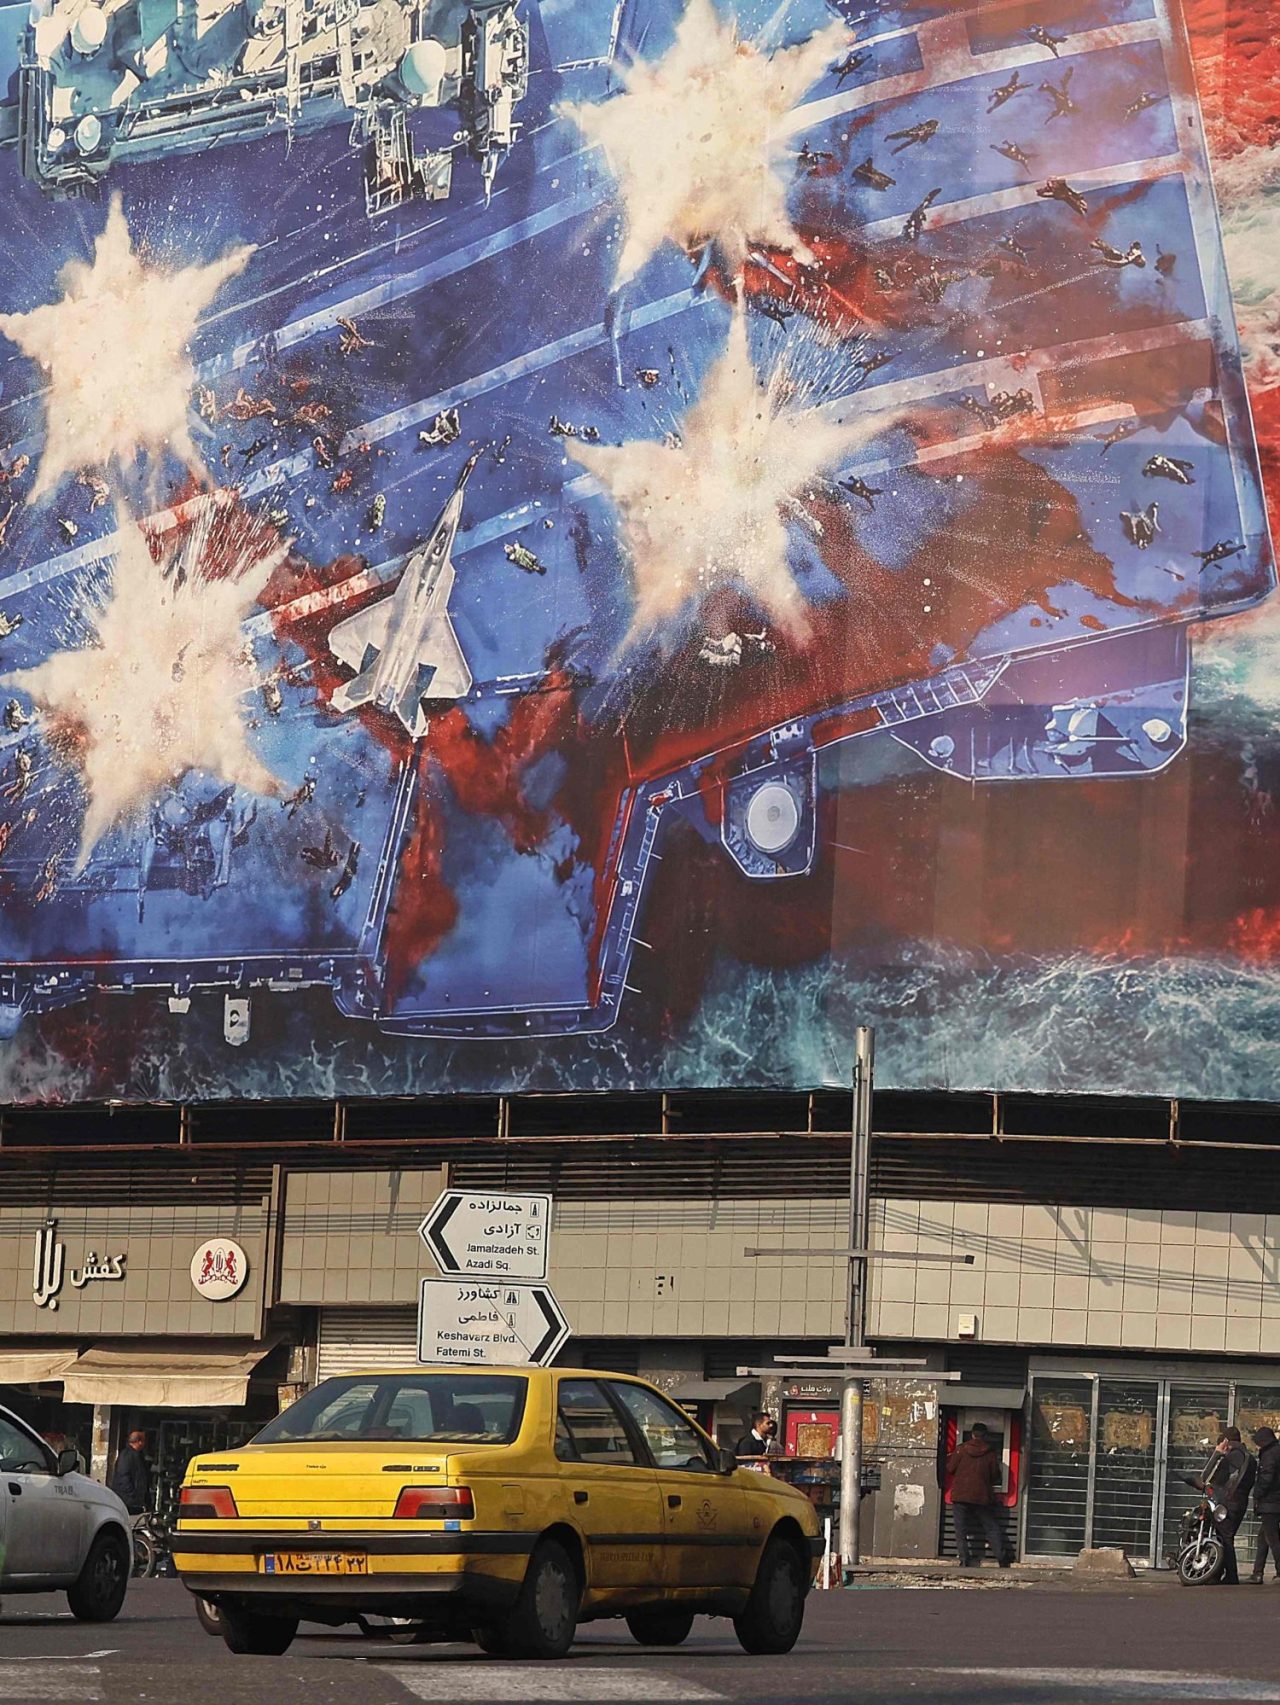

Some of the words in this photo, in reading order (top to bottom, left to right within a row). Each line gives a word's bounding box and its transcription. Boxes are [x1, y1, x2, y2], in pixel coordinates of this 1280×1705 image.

[469, 1200, 523, 1215] جمالزاده
[484, 1223, 521, 1239] آزادی
[466, 1243, 524, 1255] Jamalzadeh
[526, 1246, 540, 1256] St.
[70, 1251, 124, 1287] کفش
[466, 1258, 493, 1269] Azadi
[495, 1260, 511, 1270] Sq.
[457, 1287, 501, 1301] کشاورز
[458, 1311, 499, 1325] فاطمی
[437, 1331, 490, 1342] Keshavarz
[493, 1332, 518, 1344] Blvd.
[436, 1346, 470, 1358] Fatemi
[473, 1348, 486, 1358] St.
